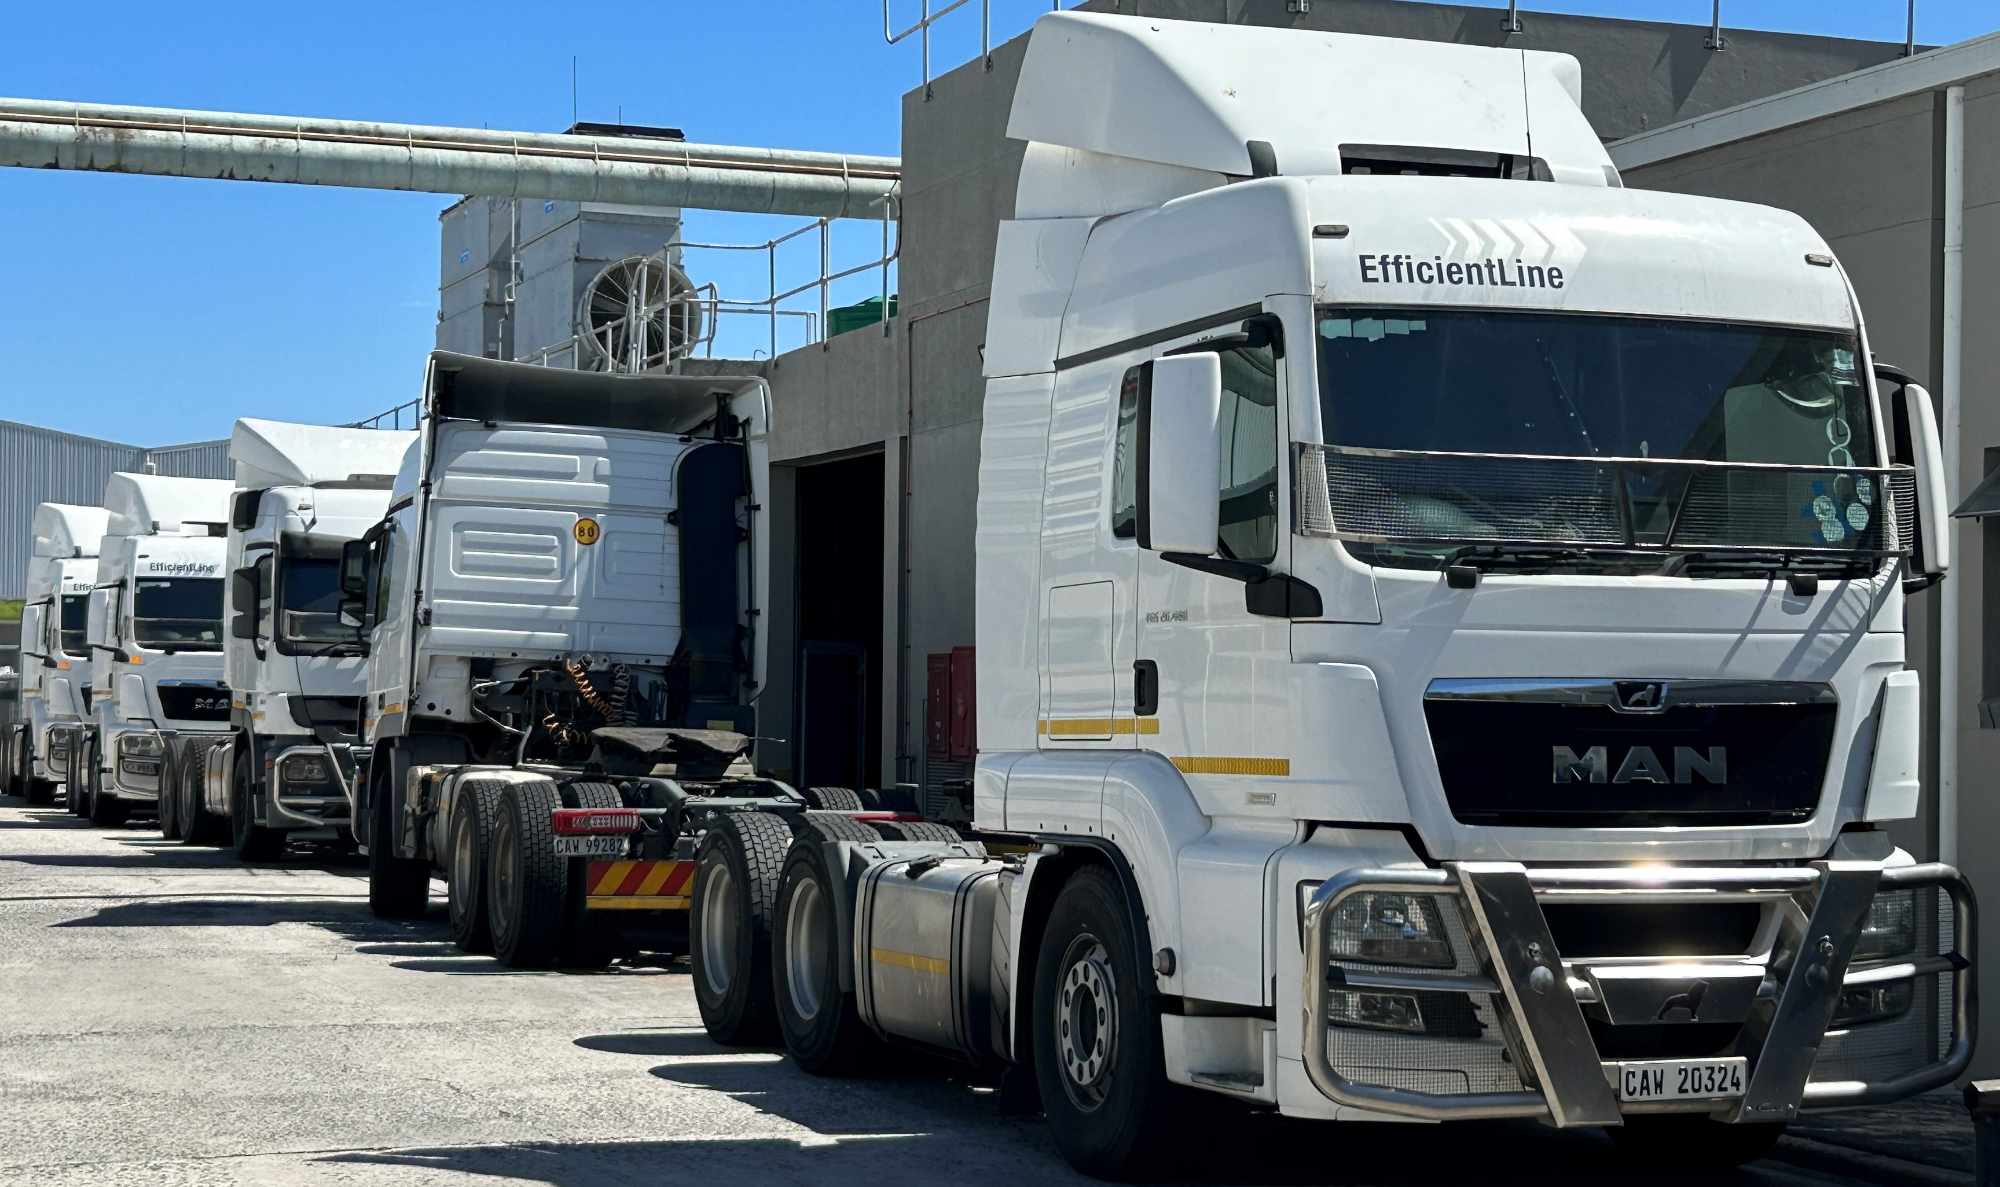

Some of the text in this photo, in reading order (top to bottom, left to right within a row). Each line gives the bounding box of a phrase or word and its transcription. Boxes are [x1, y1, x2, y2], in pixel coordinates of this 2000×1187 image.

[1359, 254, 1565, 289] EfficientLine
[578, 526, 595, 538] 80
[194, 697, 230, 710] MA
[1552, 745, 1727, 785] MAN
[556, 837, 623, 855] CAW 99282
[1625, 1065, 1741, 1097] CAW 20324
